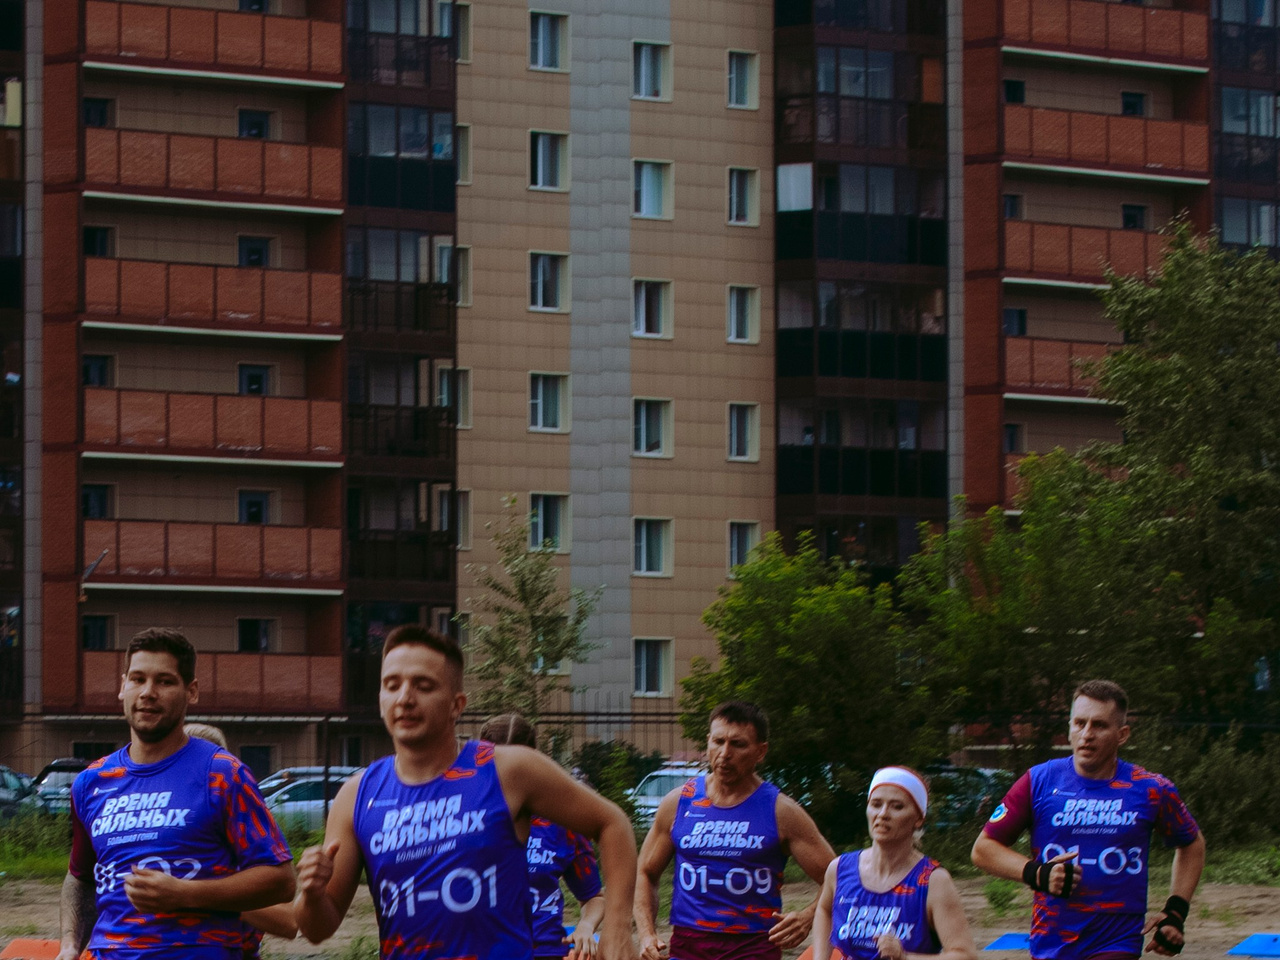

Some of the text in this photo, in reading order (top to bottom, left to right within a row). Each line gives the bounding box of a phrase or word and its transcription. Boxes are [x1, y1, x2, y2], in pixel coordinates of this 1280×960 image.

[102, 791, 172, 817] ВРЕМЯ
[382, 794, 462, 832] ВРЕМЯ
[1063, 798, 1123, 813] ВРЕМЯ
[91, 808, 190, 837] СИЛЬНЫХ
[370, 809, 486, 855] СИЛЬНЫХ
[691, 820, 750, 835] ВРЕМЯ
[1051, 811, 1138, 826] СИЛЬНЫХ
[680, 834, 765, 849] СИЛЬНЫХ
[380, 865, 498, 918] 01-01
[679, 861, 772, 895] 01-09
